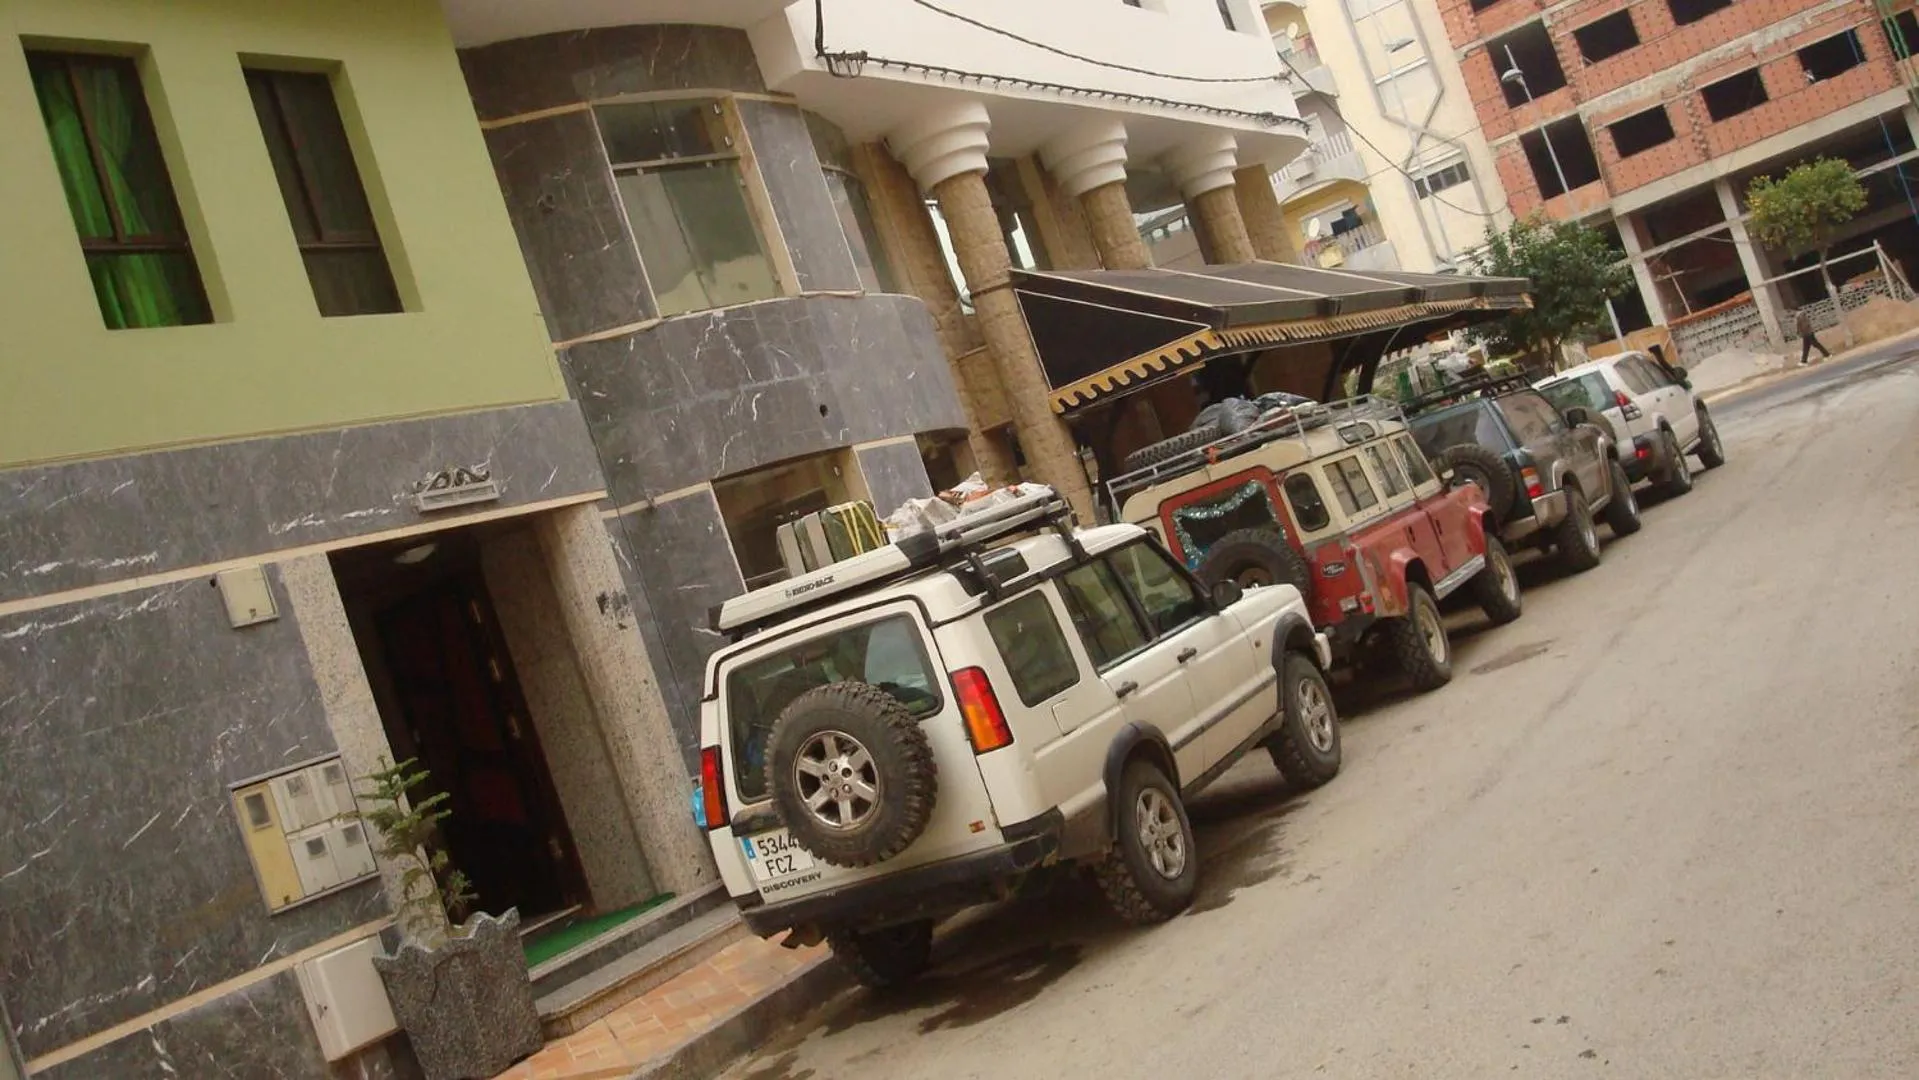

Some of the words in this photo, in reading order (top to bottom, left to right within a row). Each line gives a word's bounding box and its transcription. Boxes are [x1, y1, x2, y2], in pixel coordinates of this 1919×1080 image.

[757, 833, 798, 857] 5344
[765, 854, 797, 877] FCZ
[762, 872, 821, 894] DISCOVERY
